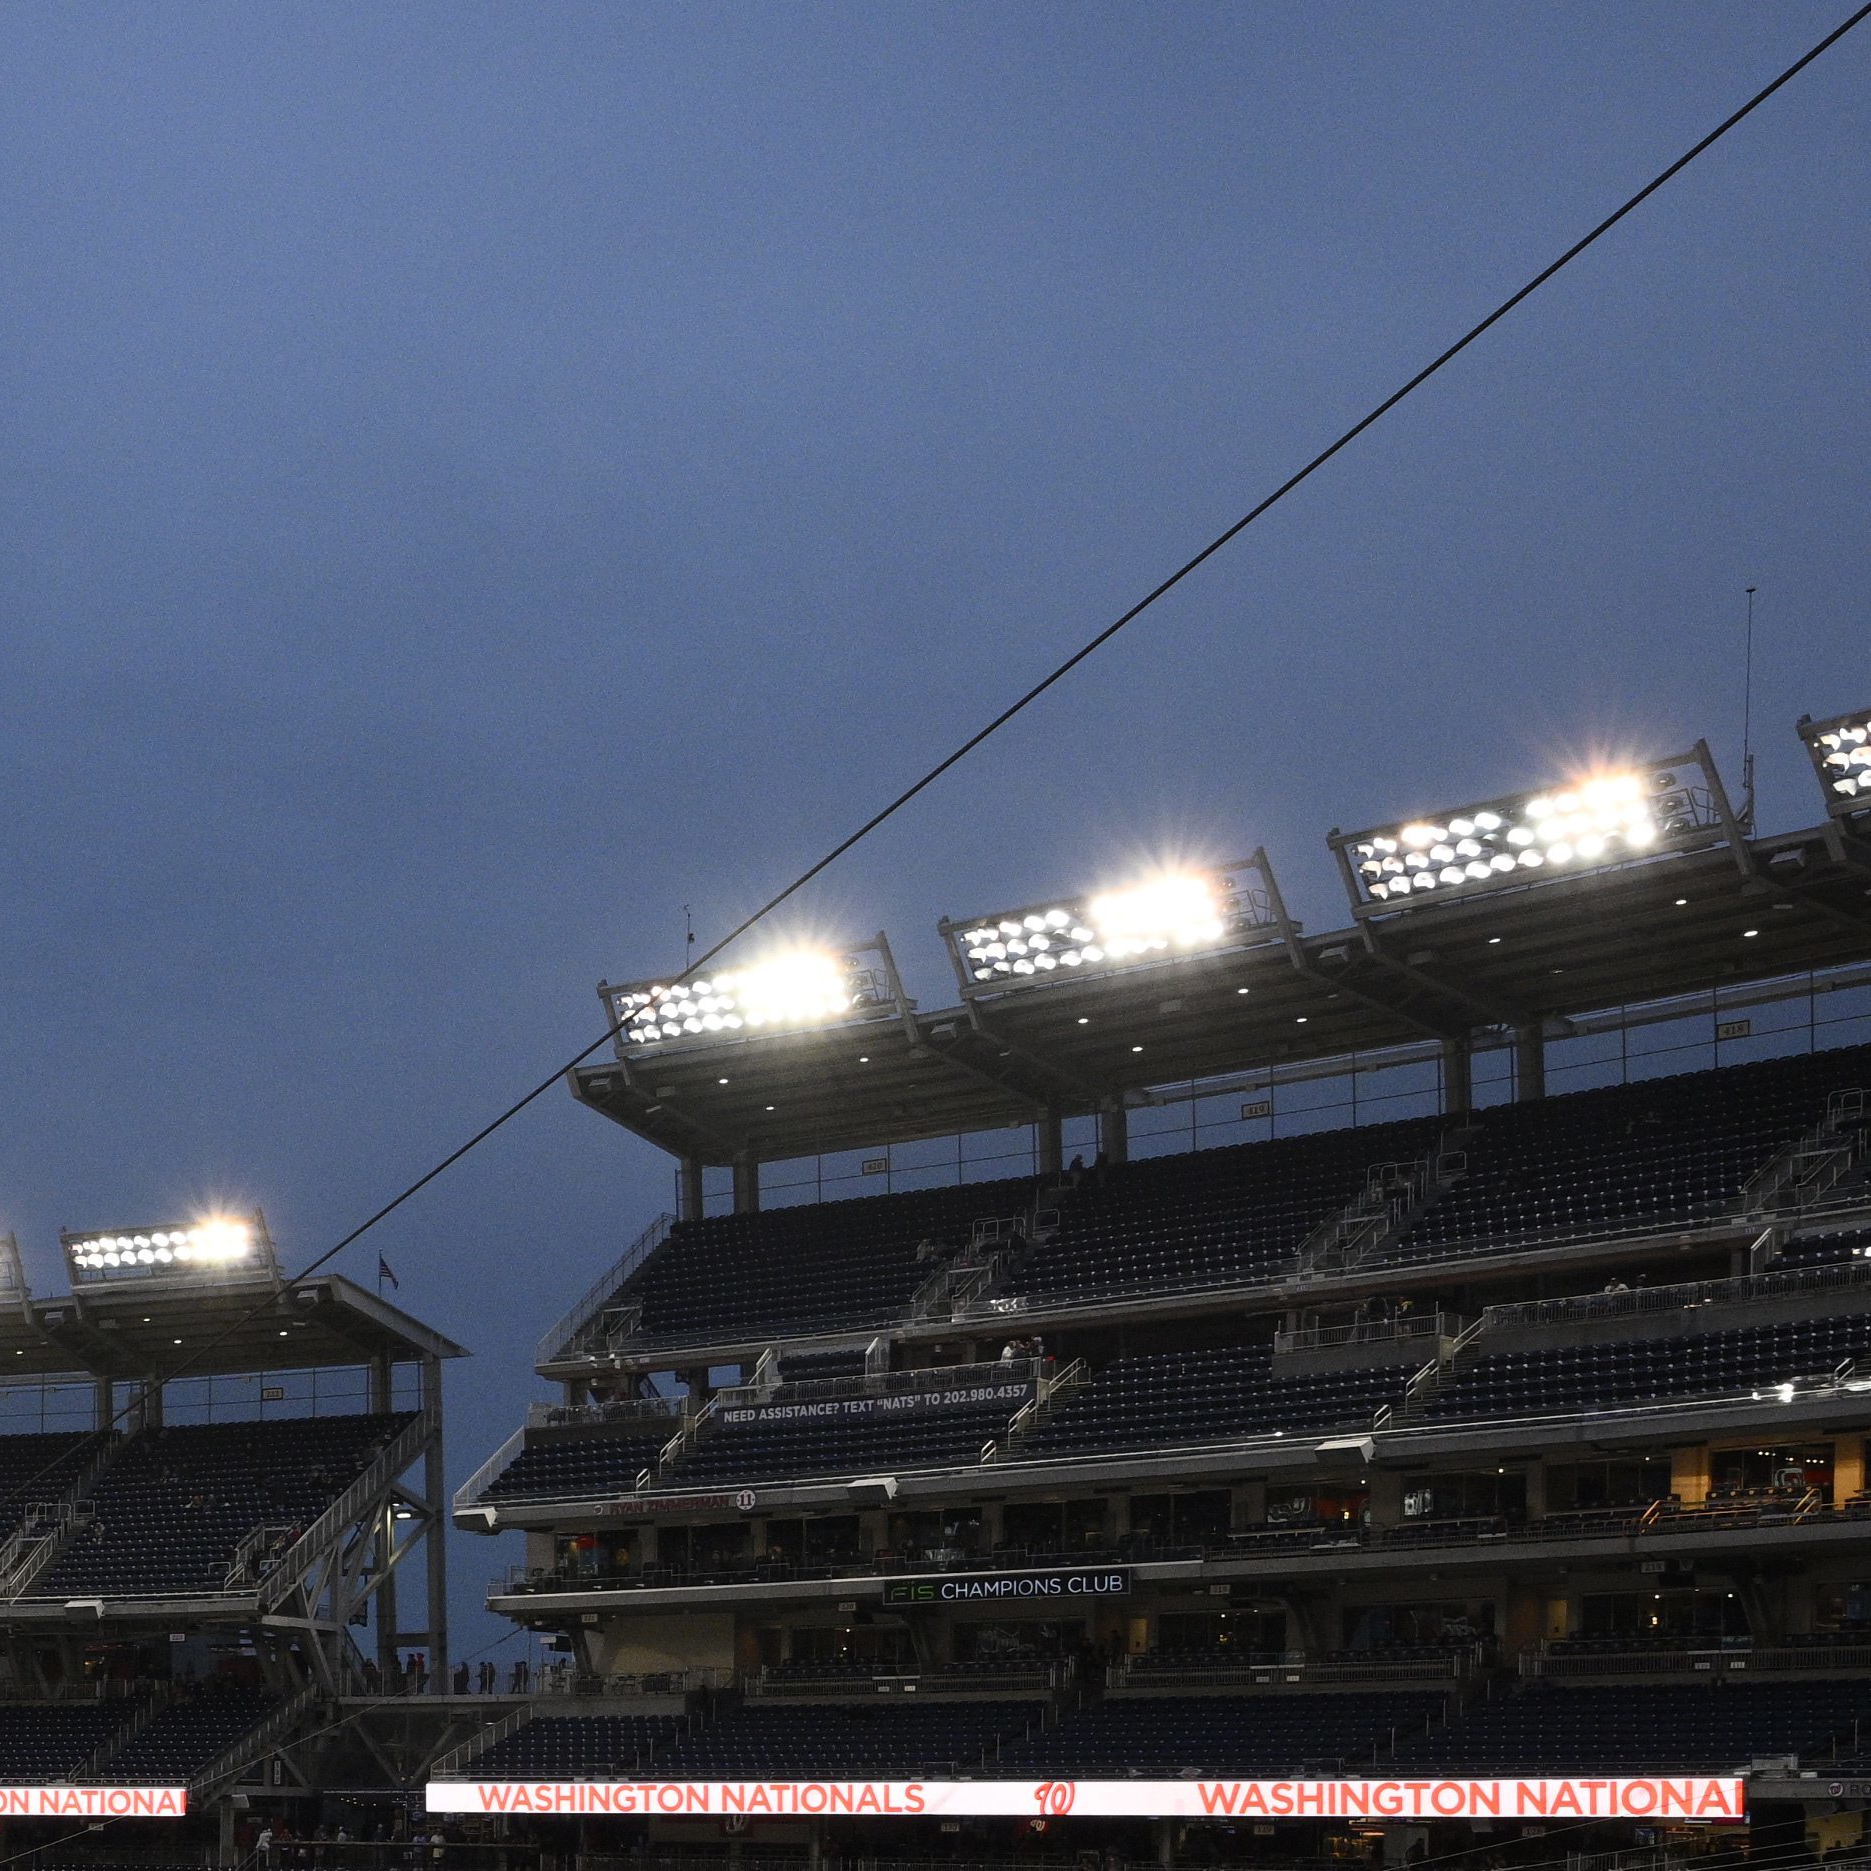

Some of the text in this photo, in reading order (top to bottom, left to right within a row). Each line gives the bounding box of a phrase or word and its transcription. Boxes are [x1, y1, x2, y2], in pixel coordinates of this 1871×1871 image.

[724, 1409, 756, 1424] NEED
[758, 1403, 840, 1421] ASSISTANCE?
[843, 1400, 875, 1414] TEXT
[923, 1393, 941, 1406] TO
[944, 1384, 1028, 1403] 202.980.4357
[941, 1575, 1123, 1600] CHAMPIONS CLUB
[478, 1784, 925, 1813] WASHINGTON NATIONALS
[1197, 1781, 1500, 1815] WASHINGTON
